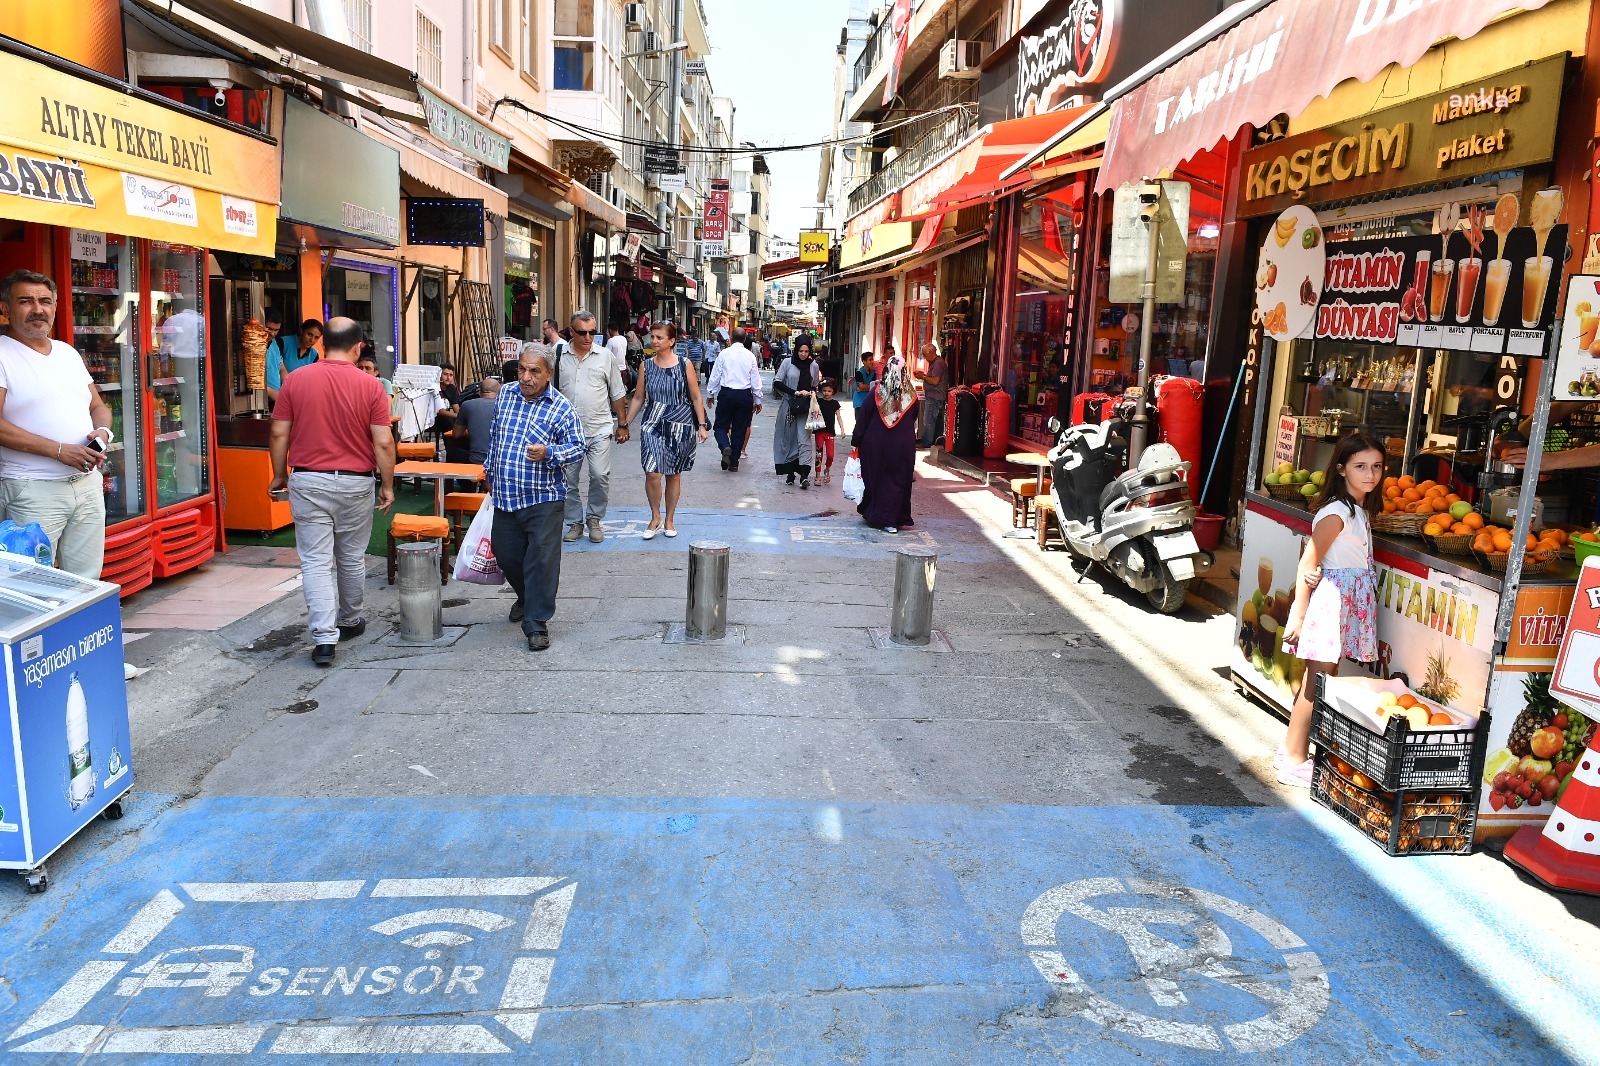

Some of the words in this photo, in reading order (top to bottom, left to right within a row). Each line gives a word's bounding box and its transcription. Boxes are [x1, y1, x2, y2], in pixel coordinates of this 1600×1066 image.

[1154, 15, 1284, 136] TARİHİ
[40, 95, 107, 149] ALTAY
[111, 116, 169, 165] TEKEL
[1436, 128, 1507, 169] plaket
[1246, 121, 1411, 201] KAŞECİM
[705, 220, 723, 229] BARIŞ
[803, 241, 825, 254] ŞOK
[1325, 248, 1403, 289] VİTAMİN
[1316, 299, 1400, 341] DÜNYASI
[1473, 328, 1504, 336] PORTAKAL
[1375, 566, 1479, 646] VİTAMİN
[78, 624, 114, 657] bilenlere
